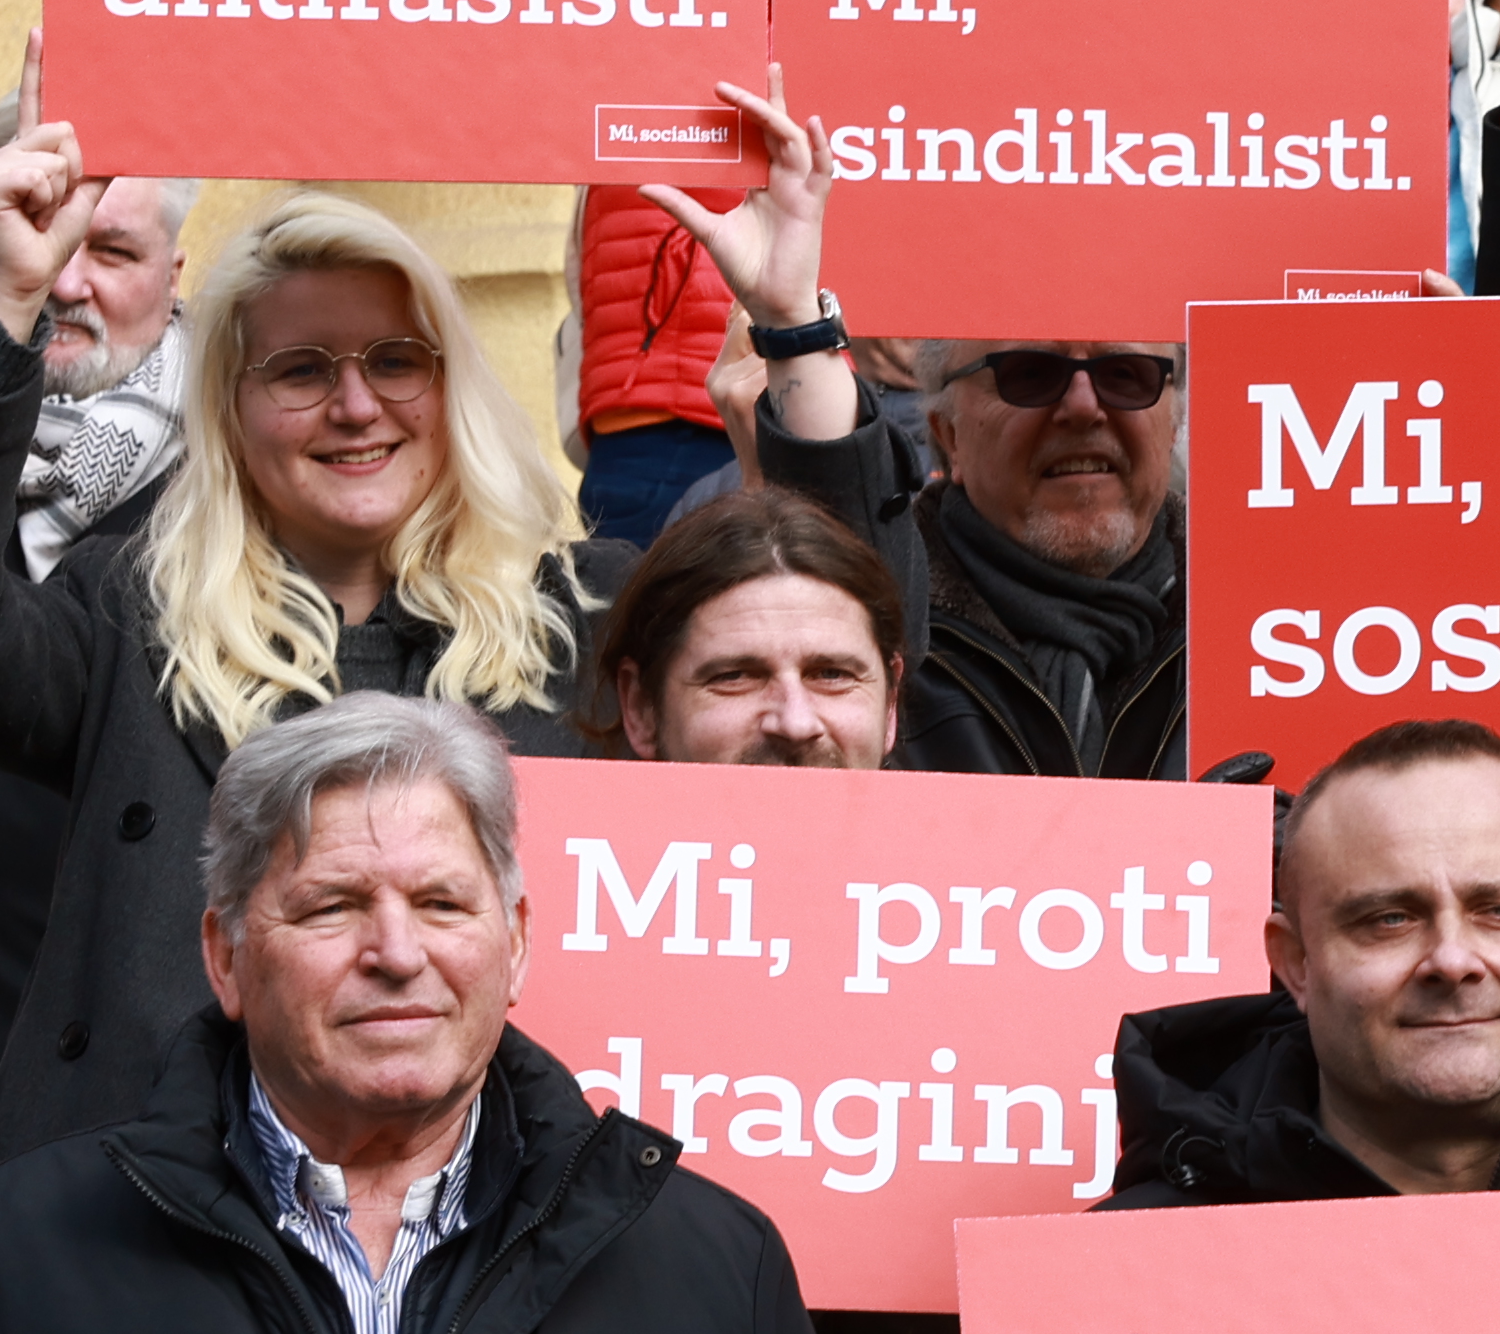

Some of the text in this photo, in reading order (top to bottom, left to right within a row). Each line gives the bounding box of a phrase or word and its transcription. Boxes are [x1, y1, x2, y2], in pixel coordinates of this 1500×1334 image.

[609, 124, 729, 144] Mi, socialisti!
[826, 105, 1410, 190] sindikalisti.
[1297, 289, 1320, 300] Mi
[1248, 380, 1481, 523] Mi,
[563, 838, 1219, 993] Mi, proti
[574, 1037, 1117, 1199] draginj
